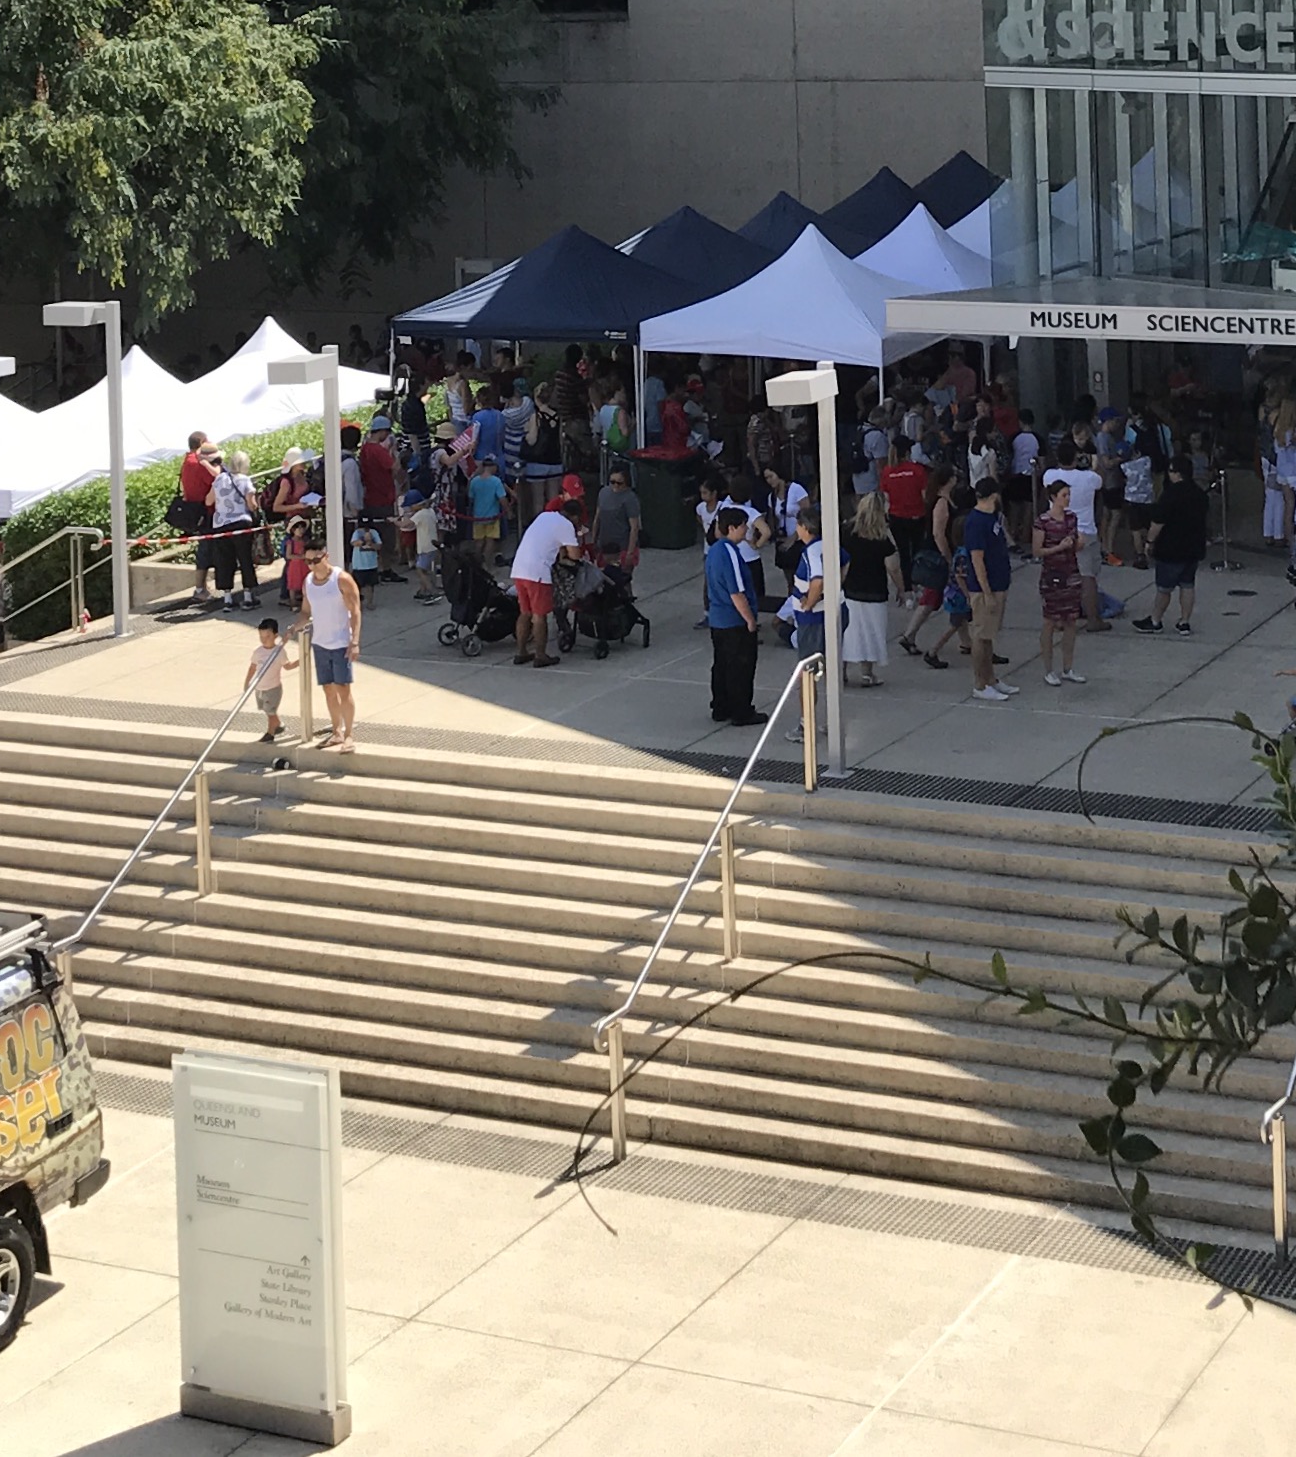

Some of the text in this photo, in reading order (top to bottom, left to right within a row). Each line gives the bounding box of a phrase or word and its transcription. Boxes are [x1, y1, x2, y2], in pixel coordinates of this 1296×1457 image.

[1029, 311, 1296, 336] MUSEUM SCIENCENTRE
[193, 1098, 261, 1119] QUEENSLAND
[194, 1114, 236, 1130] MUSEUM
[266, 1265, 281, 1276] Art
